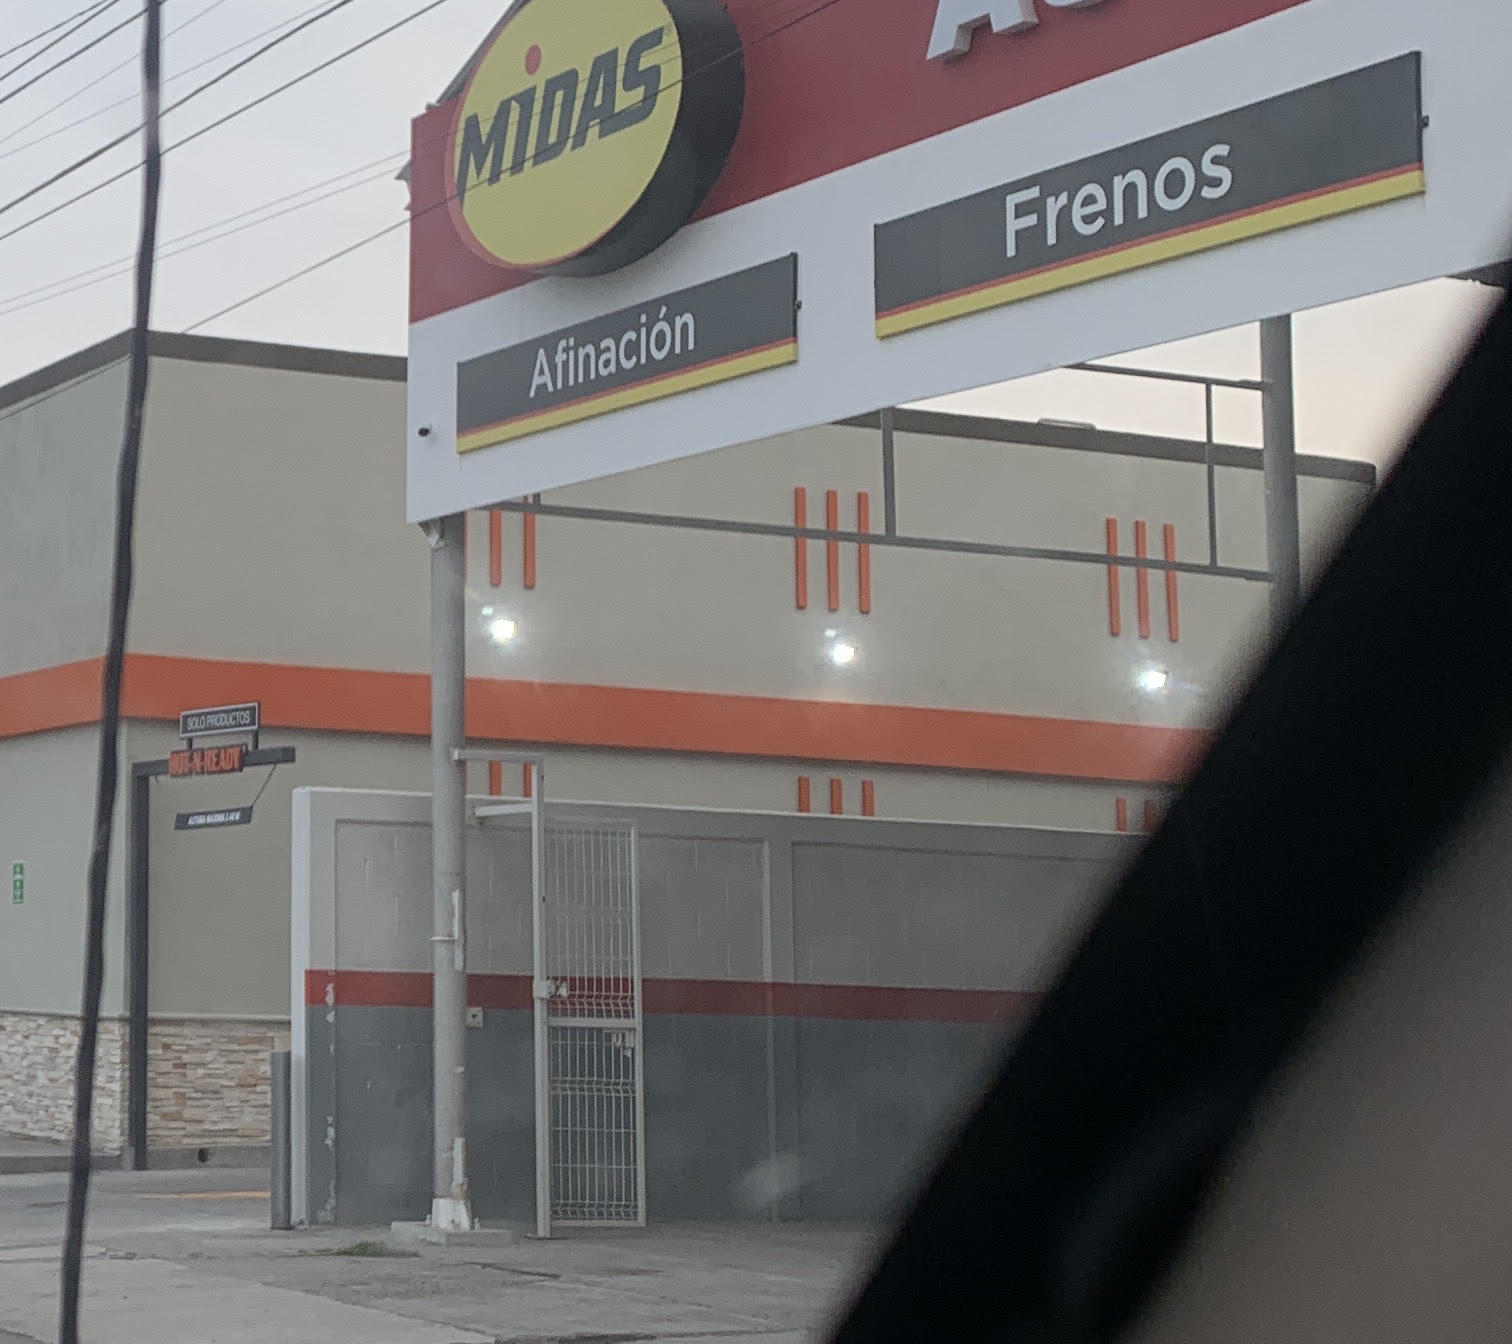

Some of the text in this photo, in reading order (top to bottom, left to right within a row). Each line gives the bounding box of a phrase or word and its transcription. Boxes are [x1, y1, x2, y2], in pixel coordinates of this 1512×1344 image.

[456, 25, 665, 206] MIDAS
[1004, 141, 1234, 258] Frenos
[528, 306, 696, 398] Afinación
[187, 710, 250, 731] SOLO PRODUCTOS
